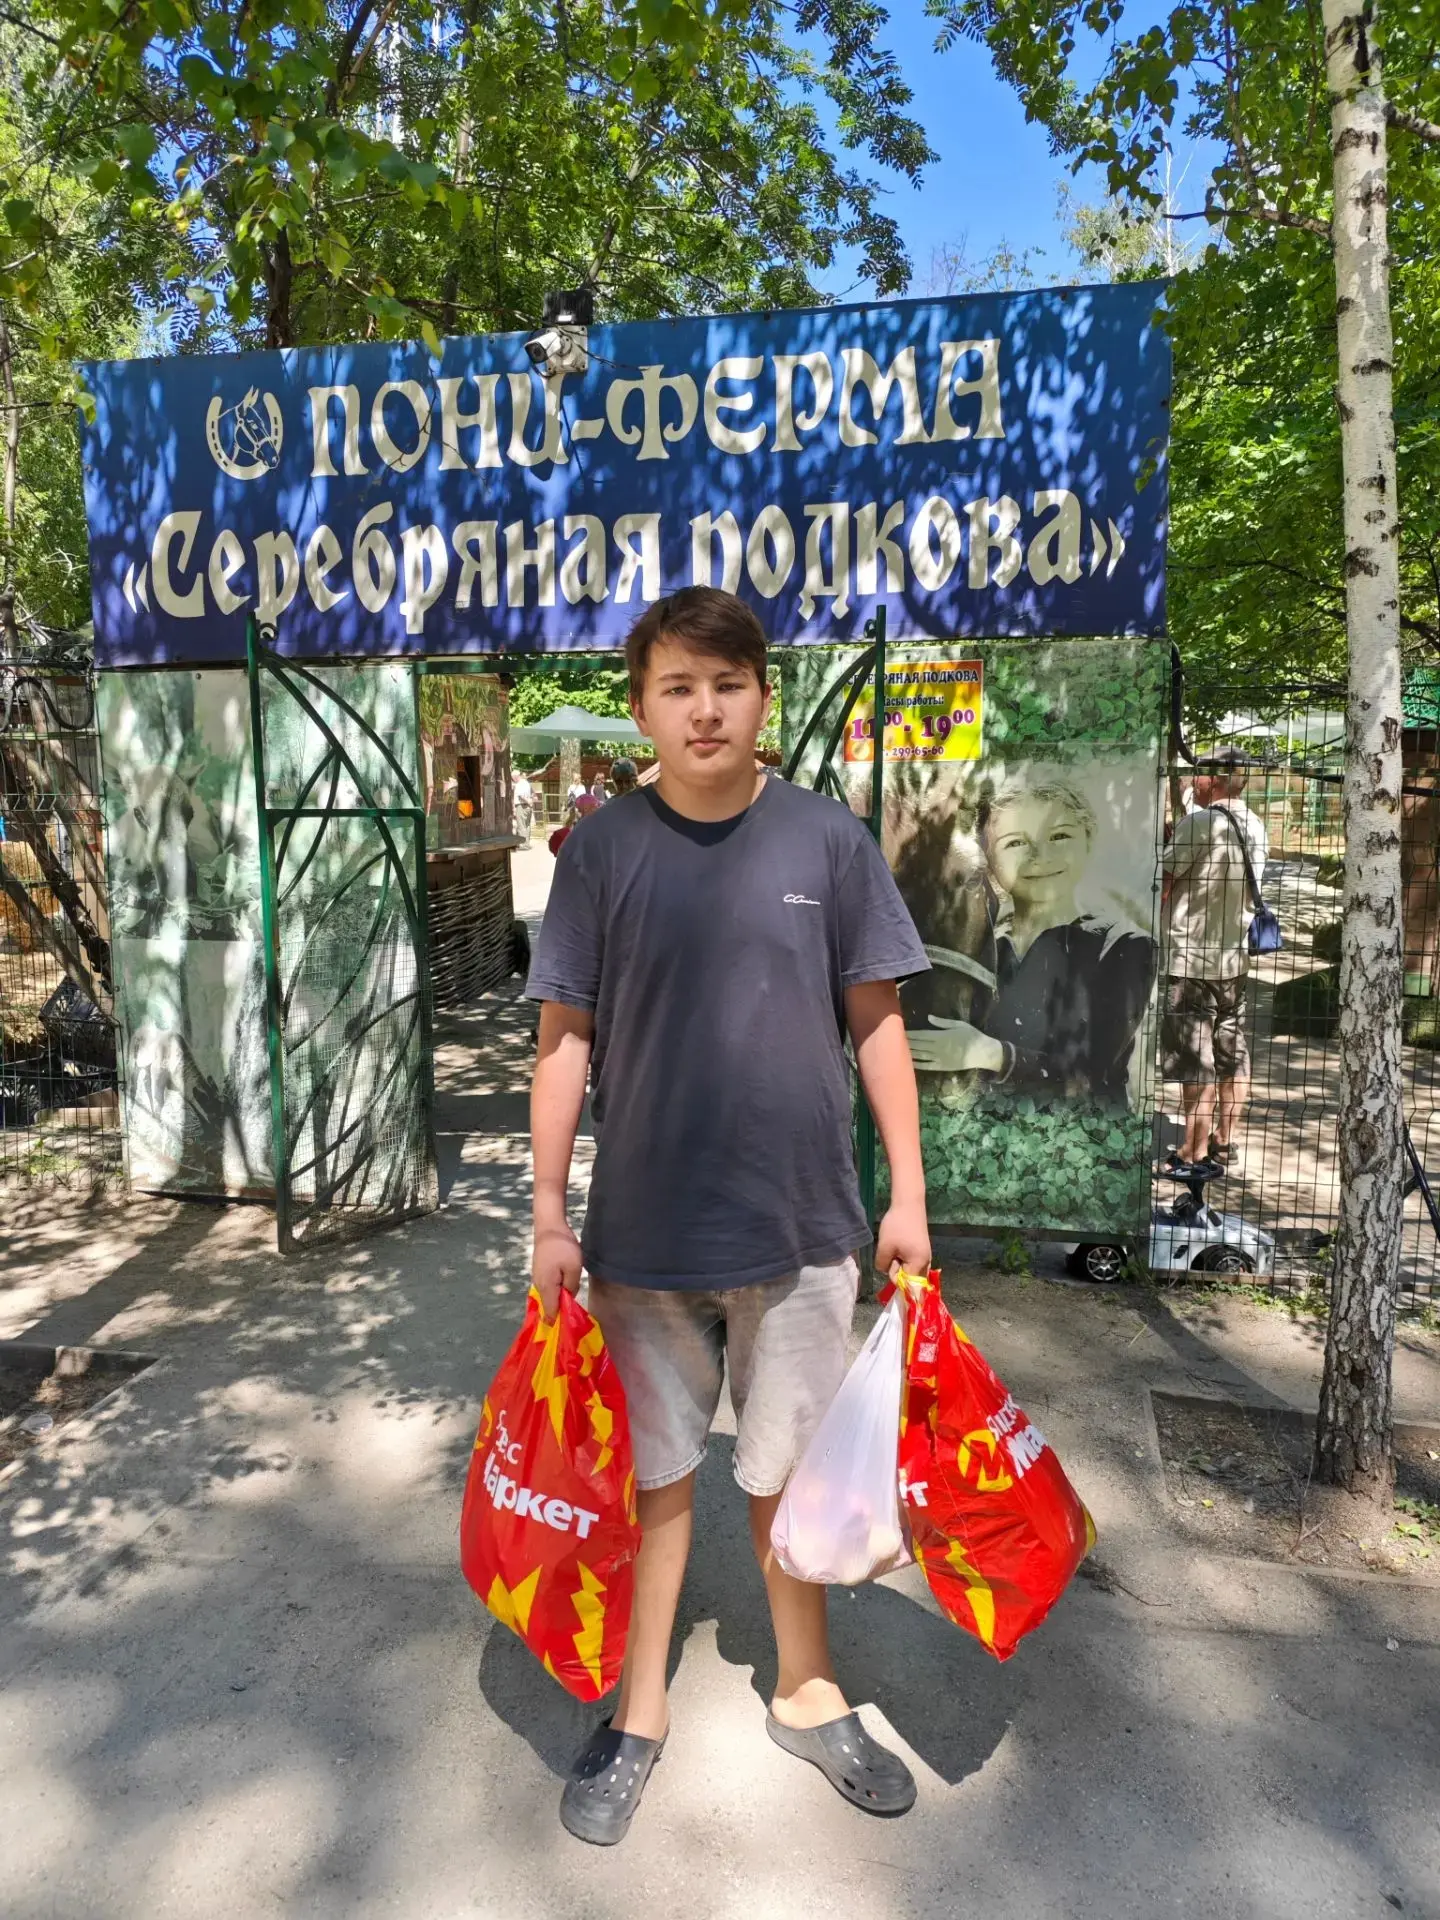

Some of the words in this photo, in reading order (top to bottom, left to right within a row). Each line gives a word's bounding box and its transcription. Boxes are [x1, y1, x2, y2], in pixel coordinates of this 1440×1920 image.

[307, 339, 1006, 477] ПОНИ-ФЕРМА
[122, 501, 662, 635] «Серебряная
[689, 488, 1126, 621] подкова»
[883, 696, 904, 707] асы
[923, 670, 979, 684] ПОДКОВА
